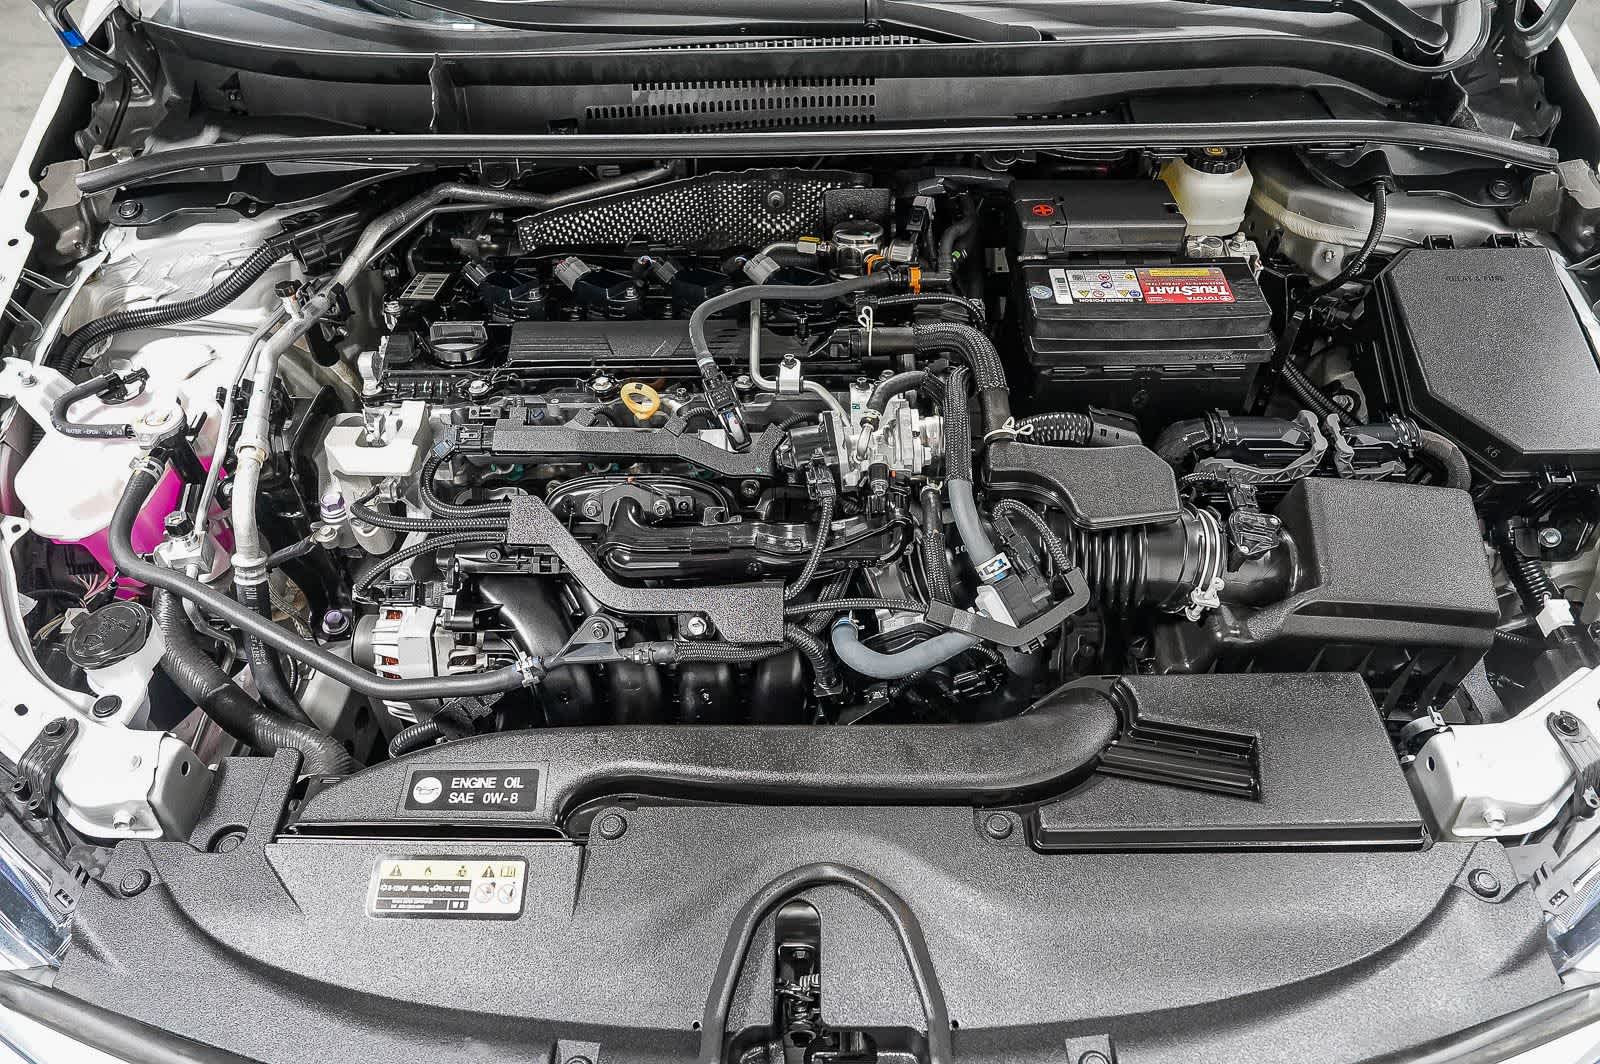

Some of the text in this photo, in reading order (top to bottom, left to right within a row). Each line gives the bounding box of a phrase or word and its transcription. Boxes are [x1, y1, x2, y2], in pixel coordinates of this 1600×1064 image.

[451, 776, 525, 789] ENGINE OIL
[447, 792, 475, 804] SAE
